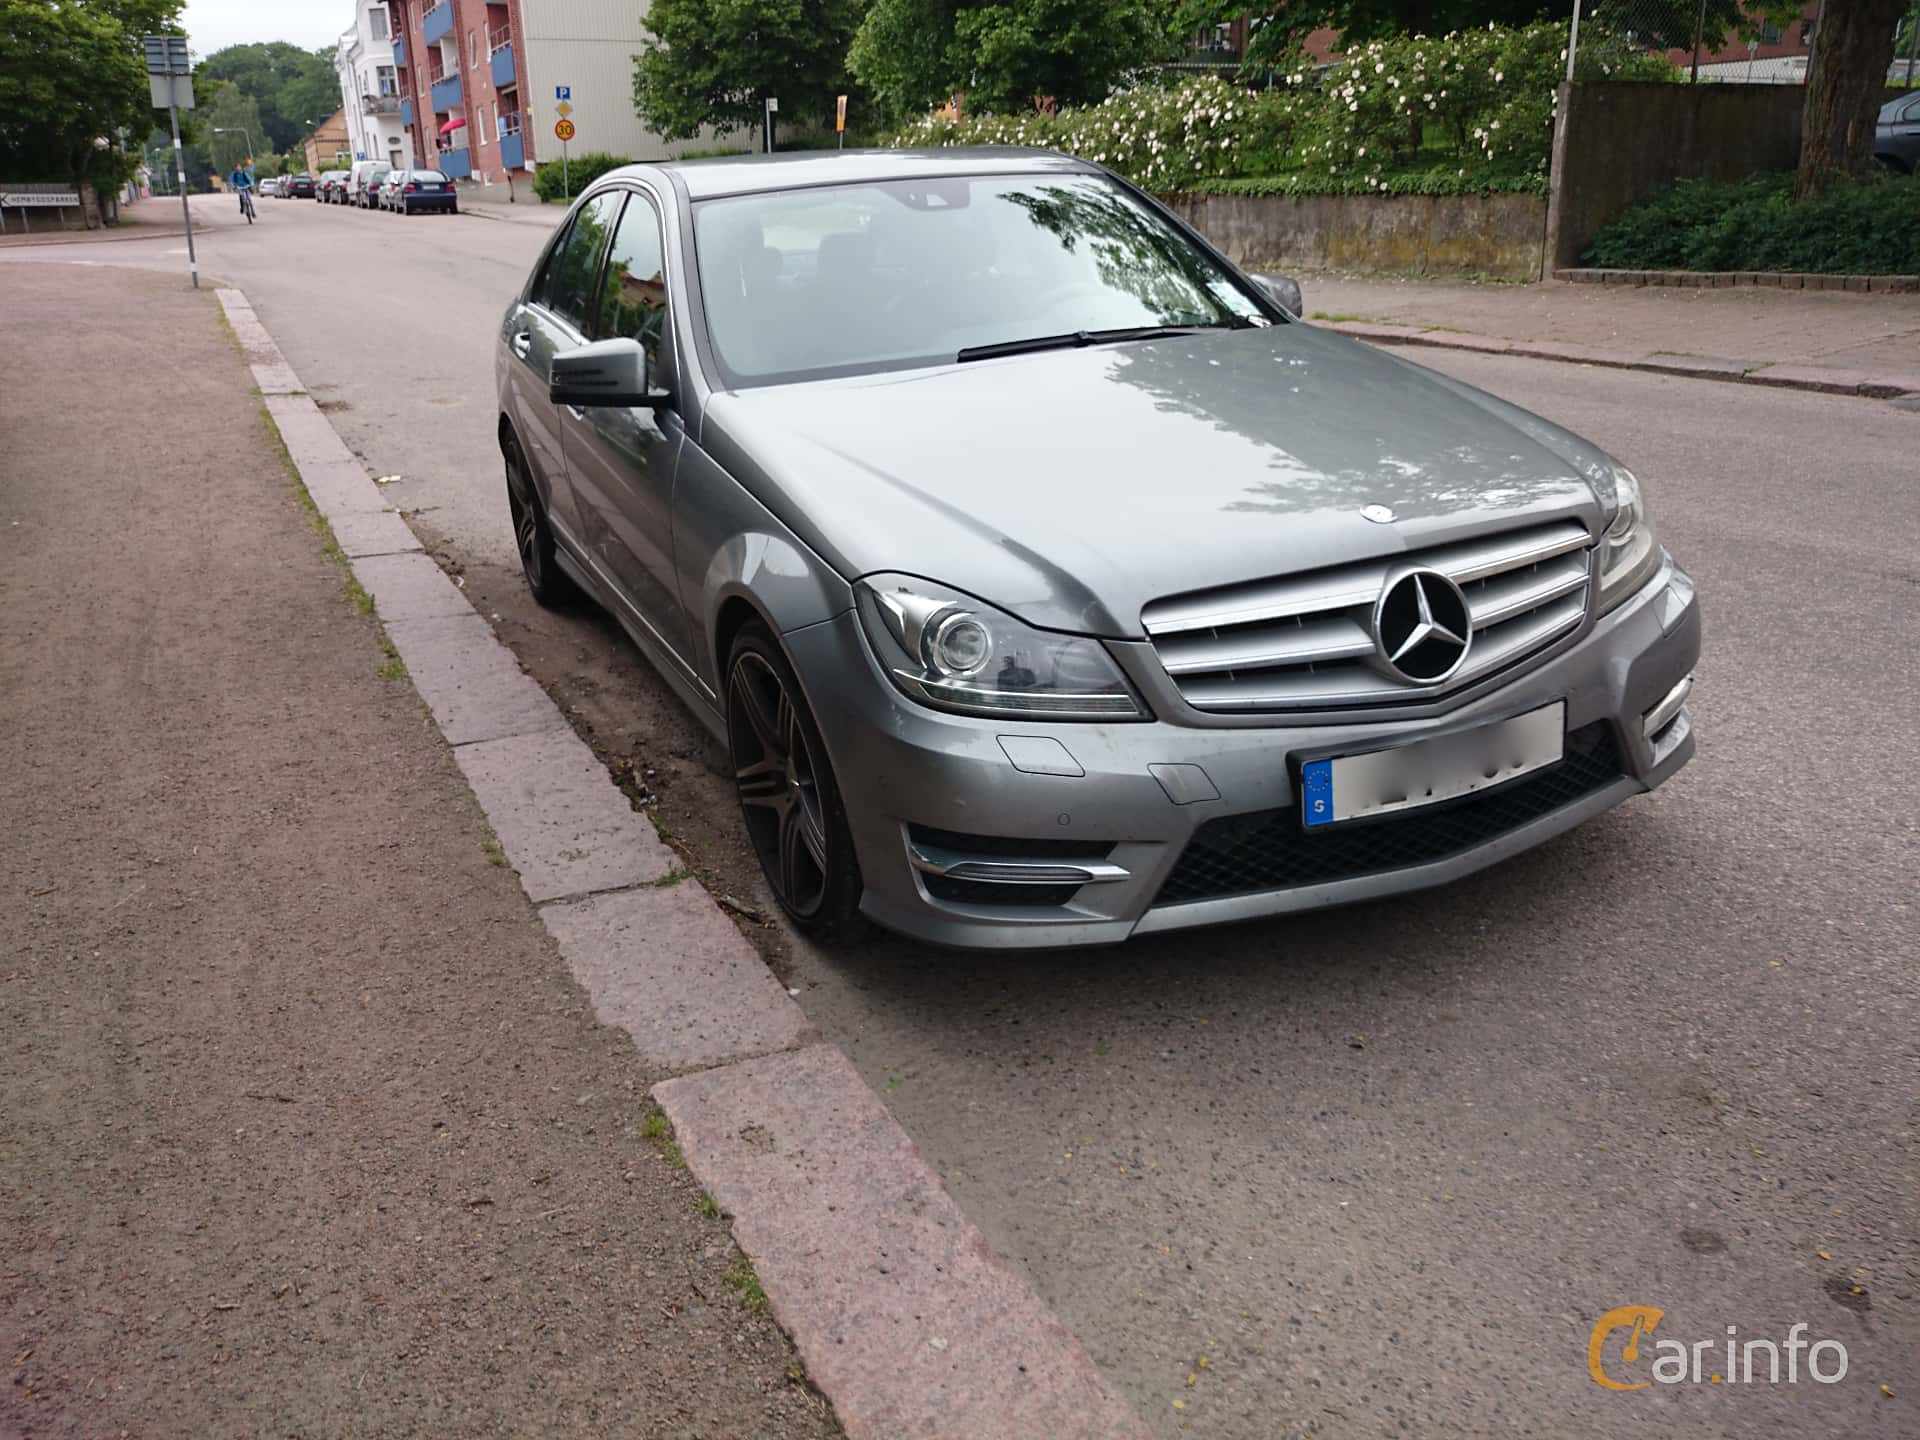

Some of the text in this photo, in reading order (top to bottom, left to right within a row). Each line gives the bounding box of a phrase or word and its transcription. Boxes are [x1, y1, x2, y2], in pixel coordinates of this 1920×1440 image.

[559, 87, 568, 99] P
[559, 124, 572, 136] 30
[1314, 799, 1325, 813] S
